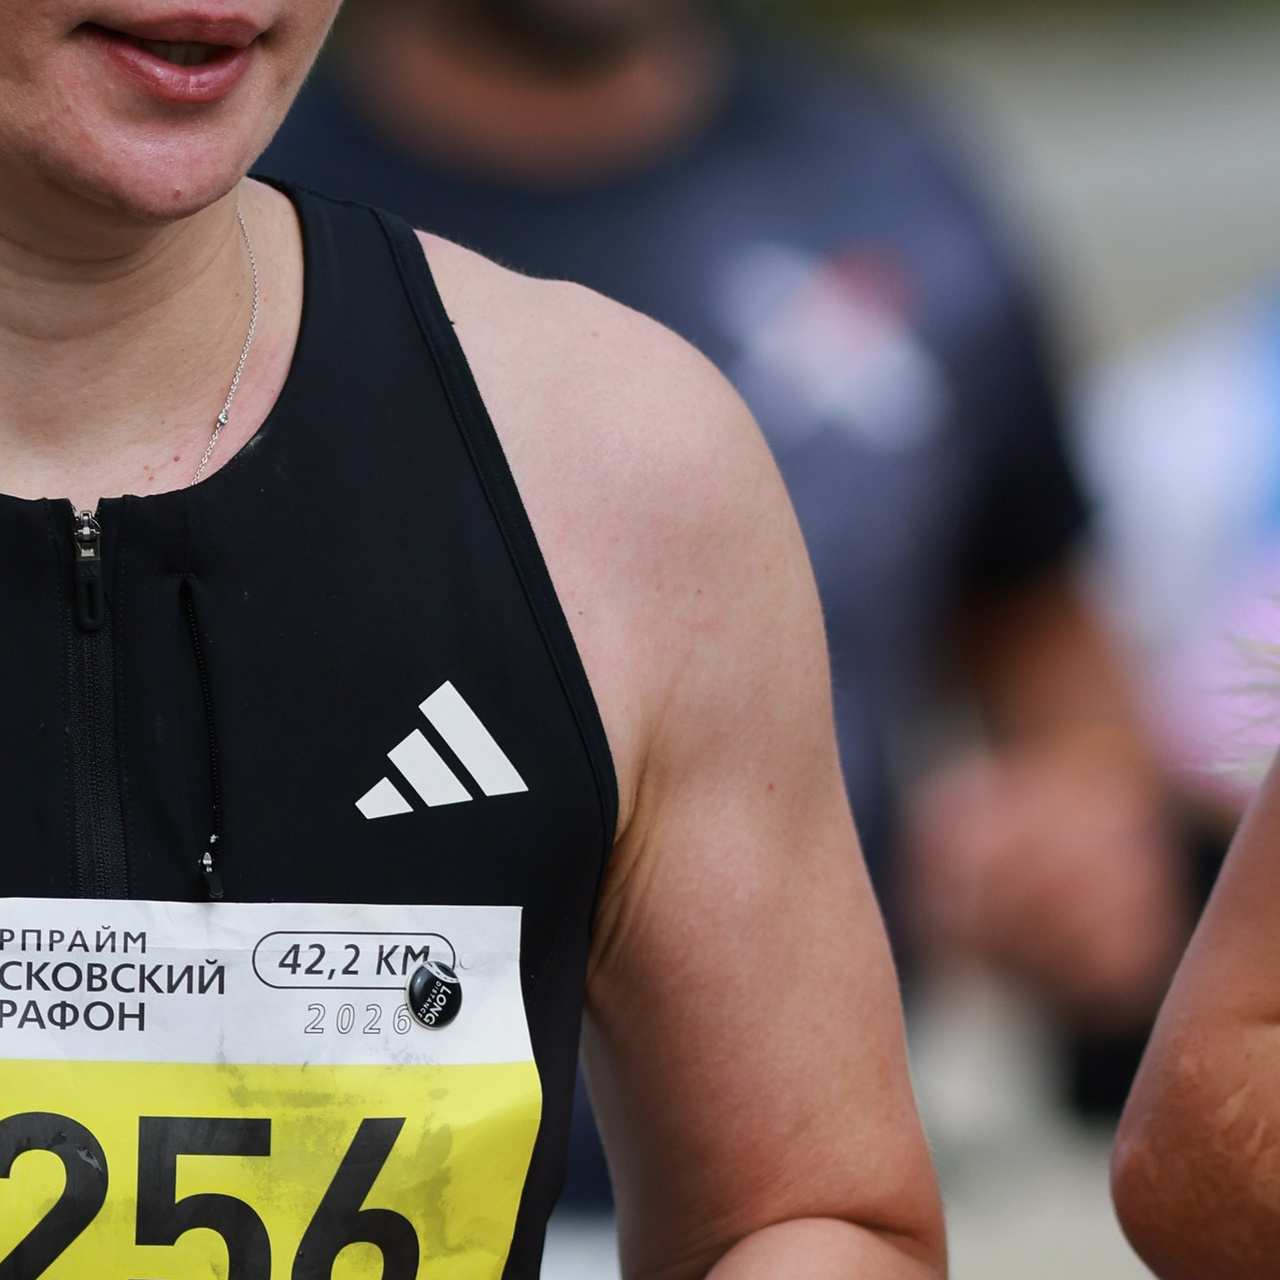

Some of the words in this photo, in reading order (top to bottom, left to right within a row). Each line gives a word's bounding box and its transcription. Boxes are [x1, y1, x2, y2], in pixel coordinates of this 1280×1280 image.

[278, 943, 361, 980] 42,2
[376, 944, 431, 976] КМ
[417, 980, 442, 1019] DISTANCE
[423, 985, 452, 1025] LONG
[304, 1003, 412, 1035] 2026
